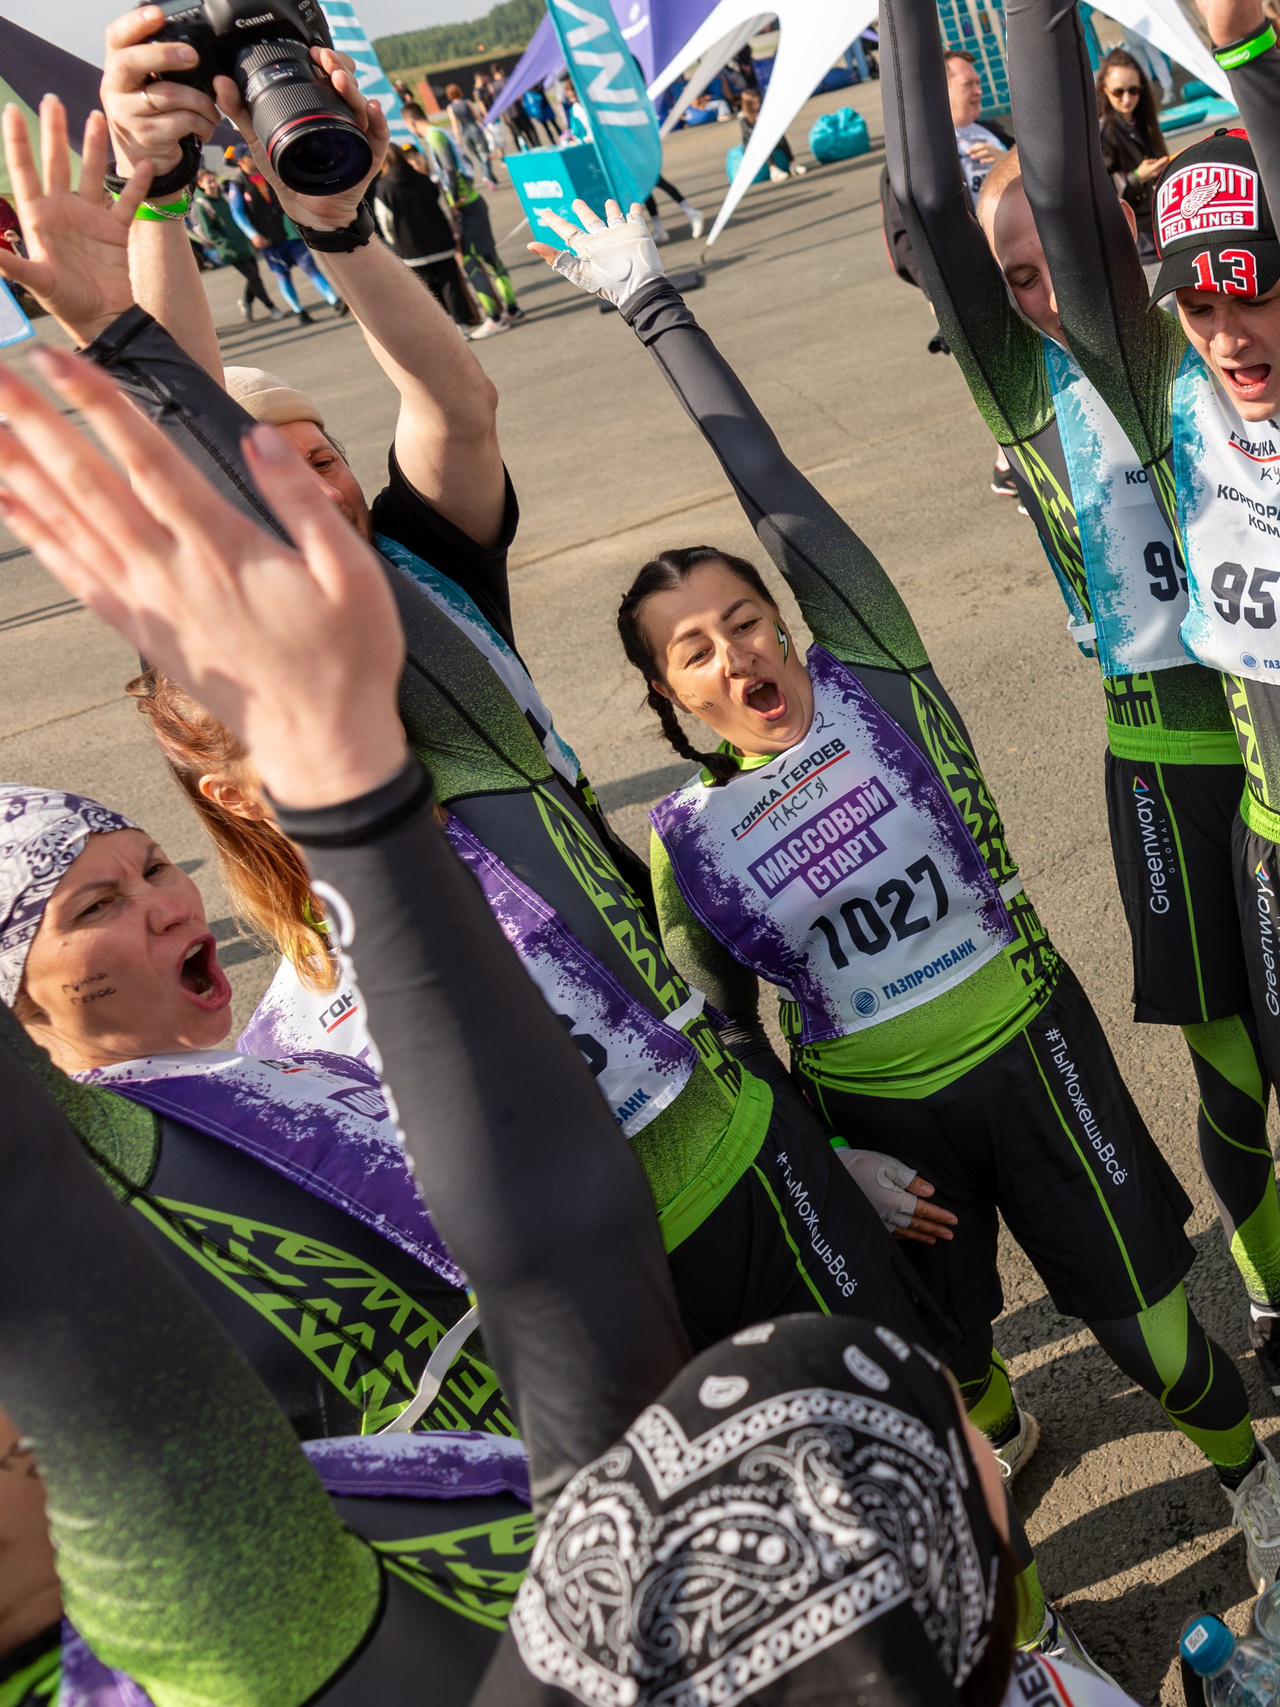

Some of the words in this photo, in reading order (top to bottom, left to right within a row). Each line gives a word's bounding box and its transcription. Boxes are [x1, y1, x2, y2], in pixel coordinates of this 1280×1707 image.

[235, 12, 275, 29] Canon
[1158, 167, 1253, 213] DETROIT
[1165, 220, 1187, 240] RED
[1190, 212, 1246, 231] WINGS
[1191, 249, 1258, 298] 13
[1229, 430, 1278, 458] ГОНКА
[814, 711, 836, 735] 2
[731, 788, 782, 838] ГОНКА
[781, 738, 847, 790] ГЕРОЕВ
[767, 777, 829, 832] НАСТЯ
[756, 779, 889, 890] МАССОВЫЙ
[806, 829, 879, 891] СТАРТ
[1134, 791, 1171, 914] Greenway
[1159, 818, 1176, 874] GLOBAL
[809, 854, 949, 970] 1027
[882, 938, 978, 999] ГАЗПРОМБАНК
[1257, 876, 1280, 1016] Greenway
[1045, 1028, 1128, 1186] #ТыМожешьВсё
[776, 1151, 858, 1297] #ТыМожешьВсё
